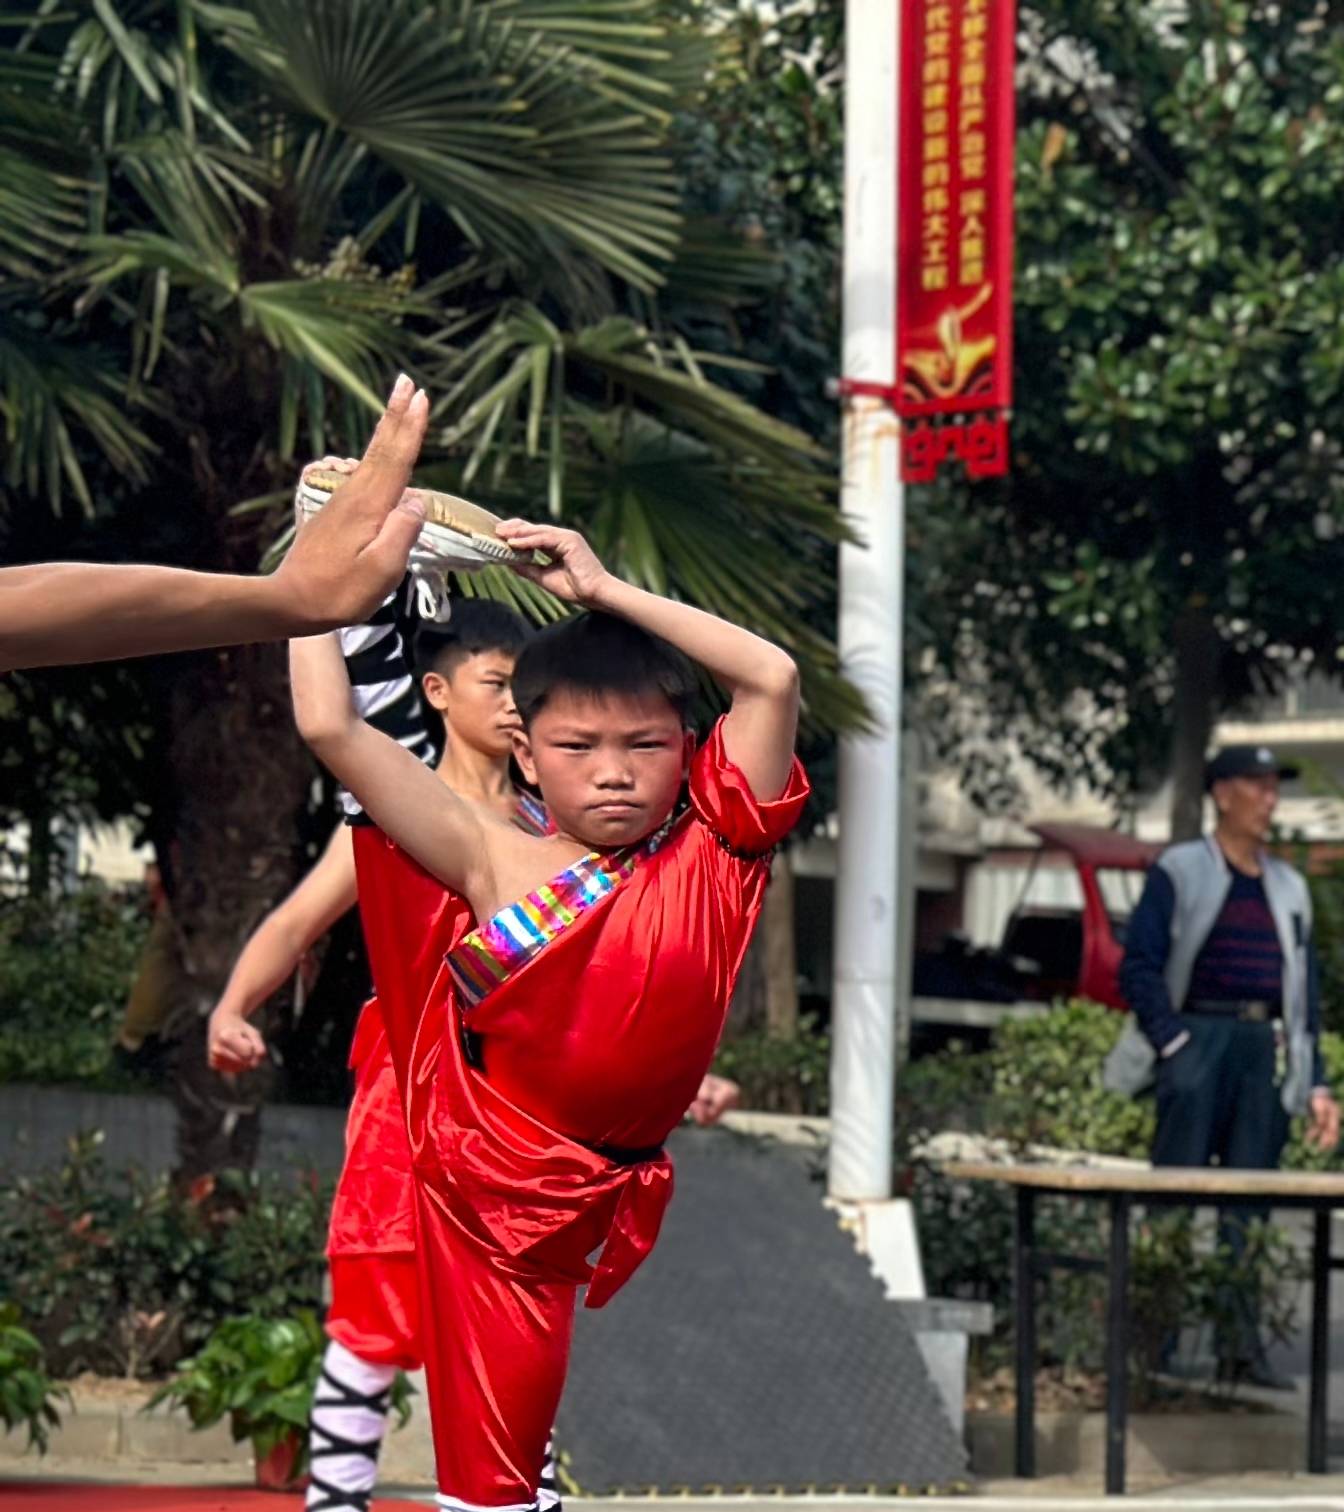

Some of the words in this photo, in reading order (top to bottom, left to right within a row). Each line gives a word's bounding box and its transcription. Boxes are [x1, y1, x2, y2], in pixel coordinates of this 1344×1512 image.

[922, 0, 950, 289] 代党的建设新的伟大工程
